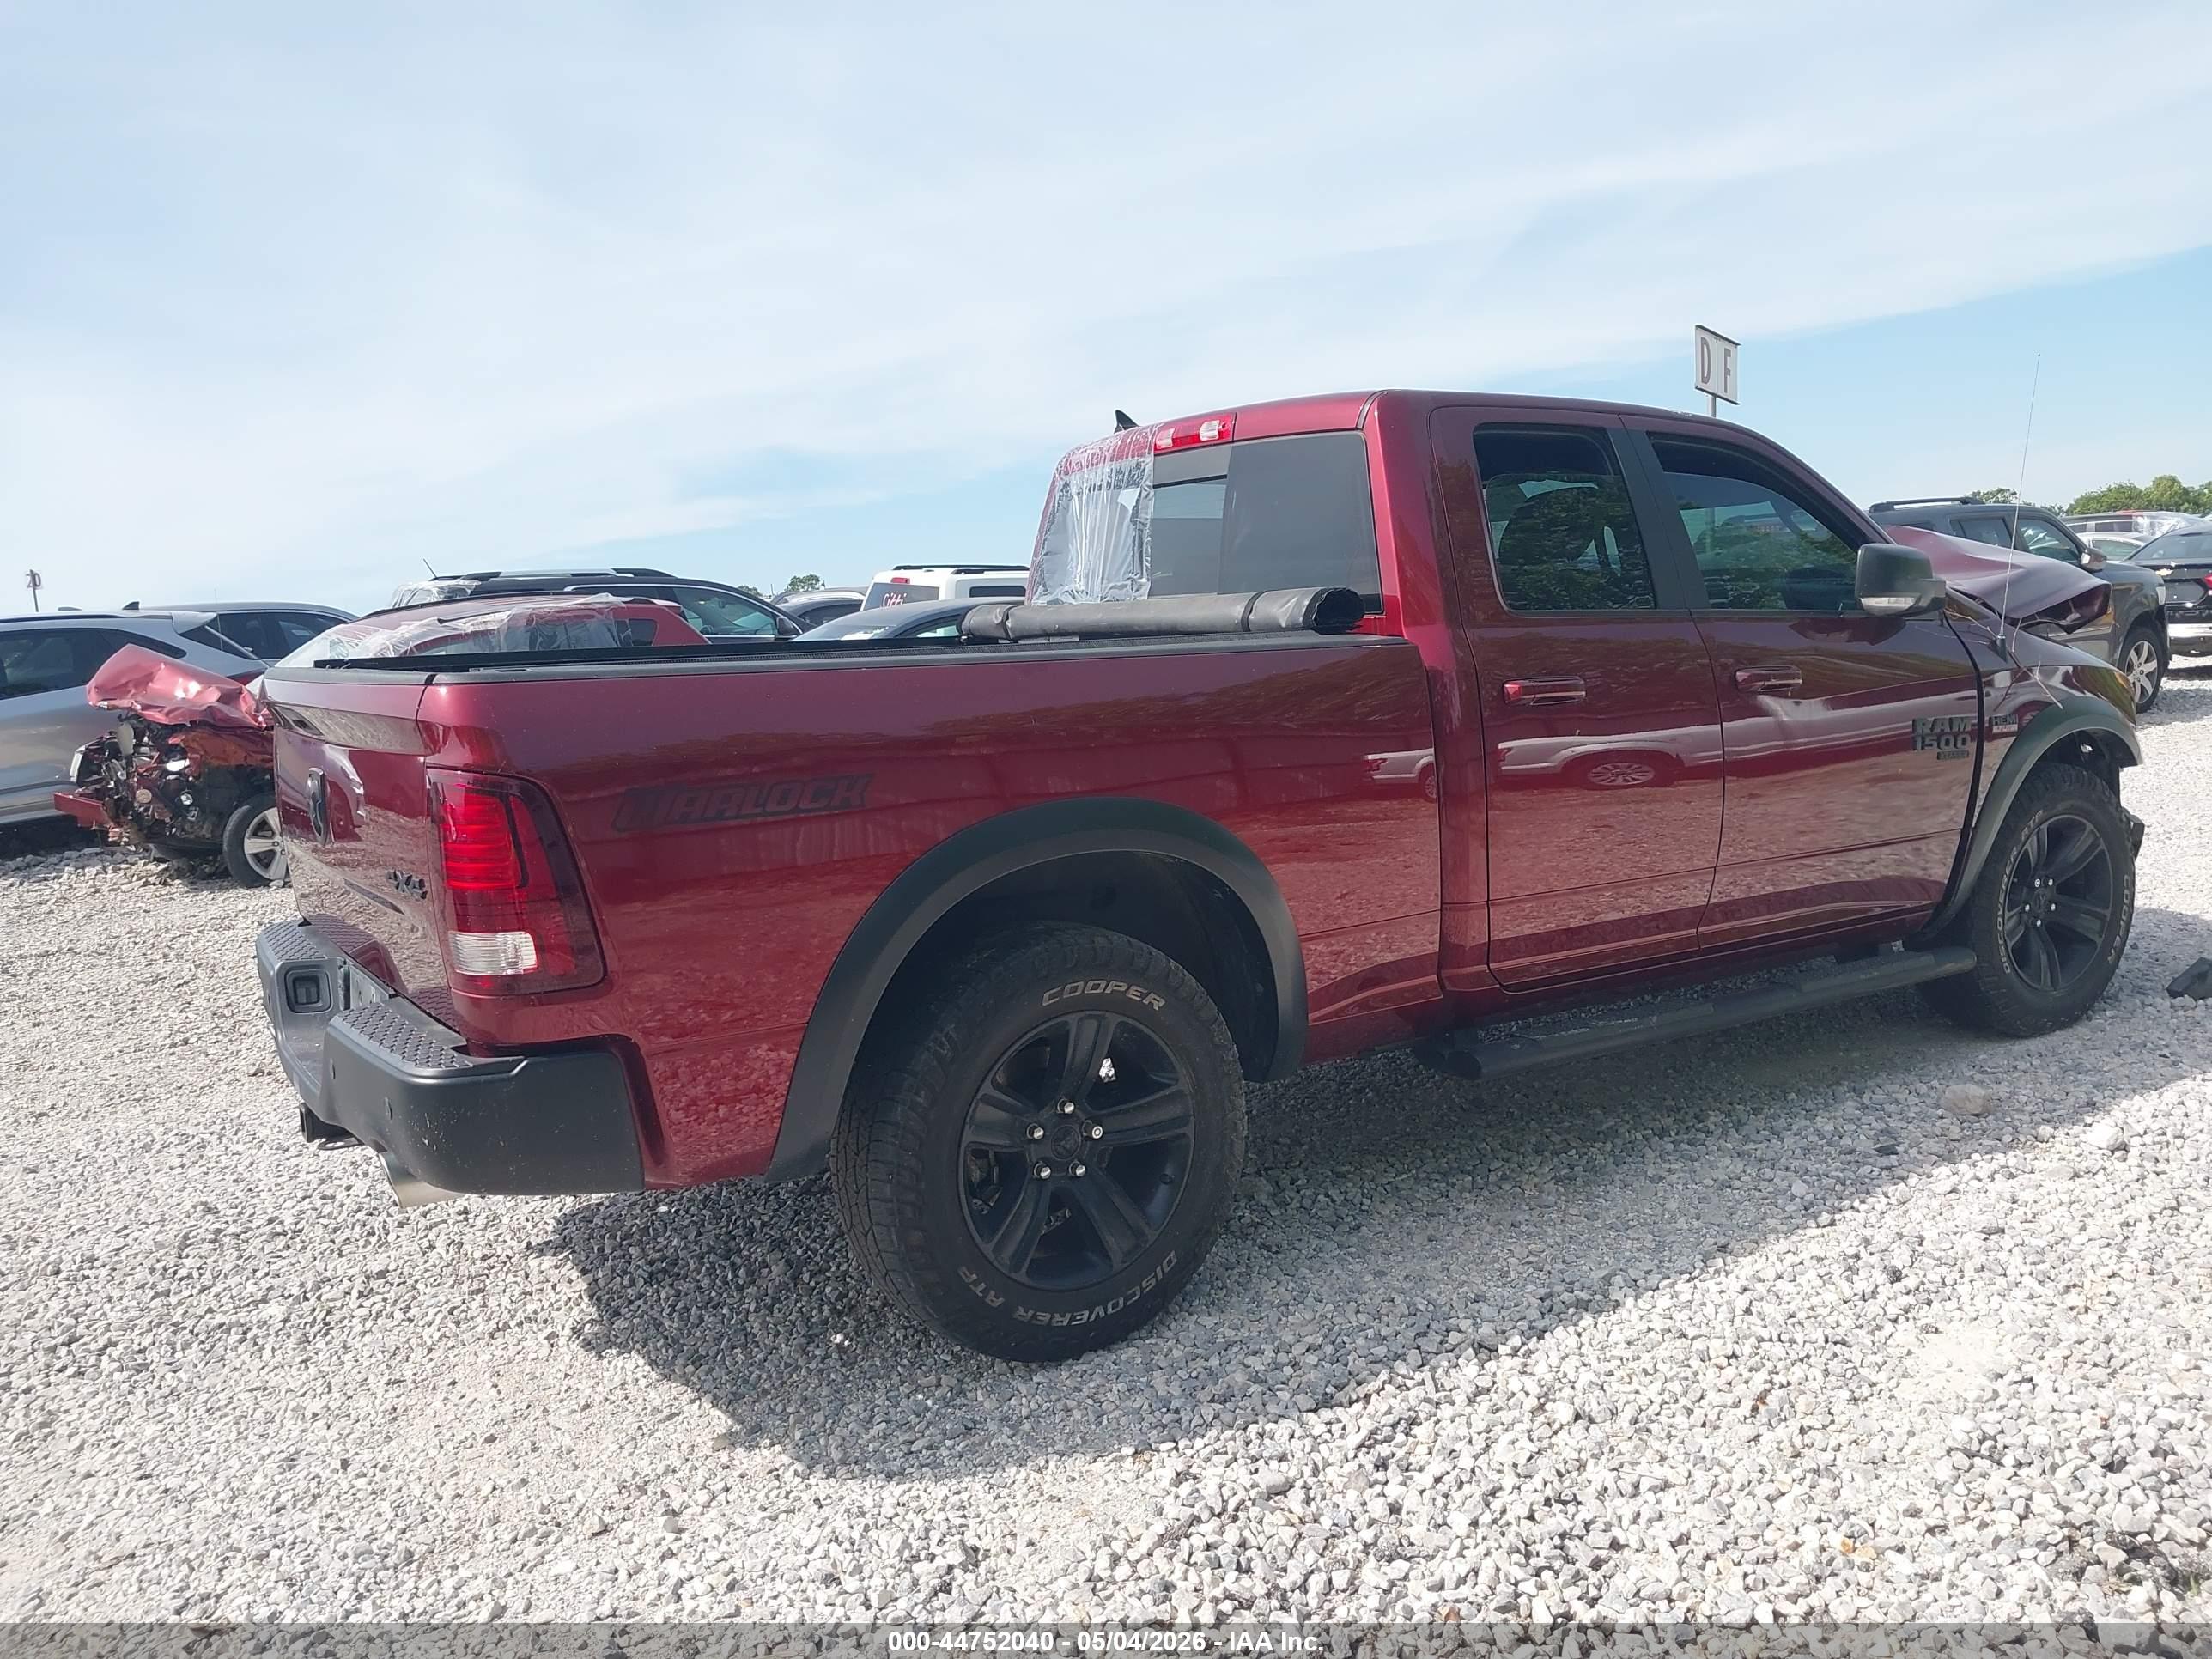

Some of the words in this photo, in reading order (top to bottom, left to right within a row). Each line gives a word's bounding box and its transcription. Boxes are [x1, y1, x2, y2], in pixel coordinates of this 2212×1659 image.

[1912, 716, 1971, 733] RAM
[1992, 714, 2019, 726] HEMI
[1912, 733, 1971, 751] 1500
[1042, 980, 1165, 1011] COOPER
[1012, 1250, 1178, 1326] DISCOVERER
